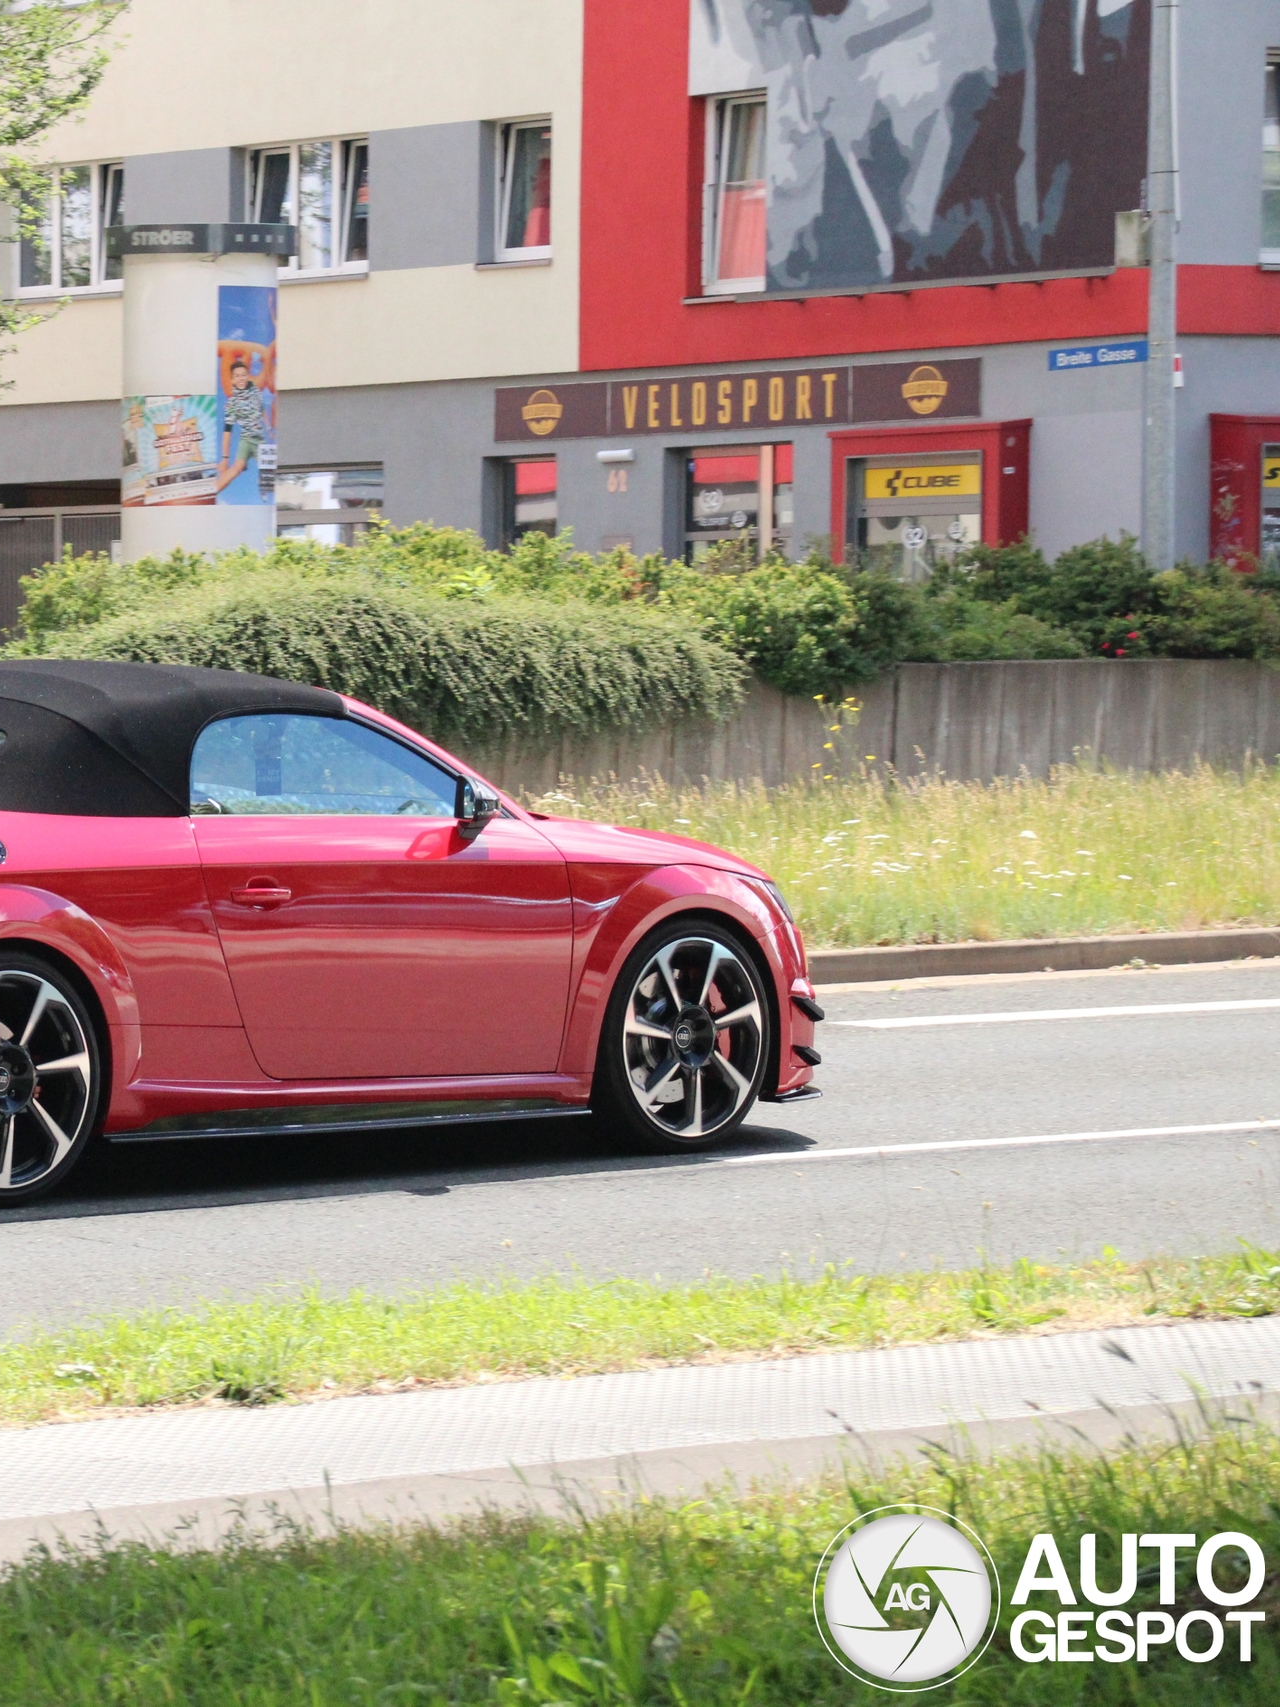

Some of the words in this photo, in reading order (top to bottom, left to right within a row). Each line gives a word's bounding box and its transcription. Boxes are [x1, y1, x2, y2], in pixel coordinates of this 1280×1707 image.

[1056, 351, 1093, 367] Breite
[1097, 348, 1137, 363] Gasse
[622, 373, 837, 429] VELOSPORT
[608, 469, 628, 493] 62
[903, 474, 961, 490] CUBE
